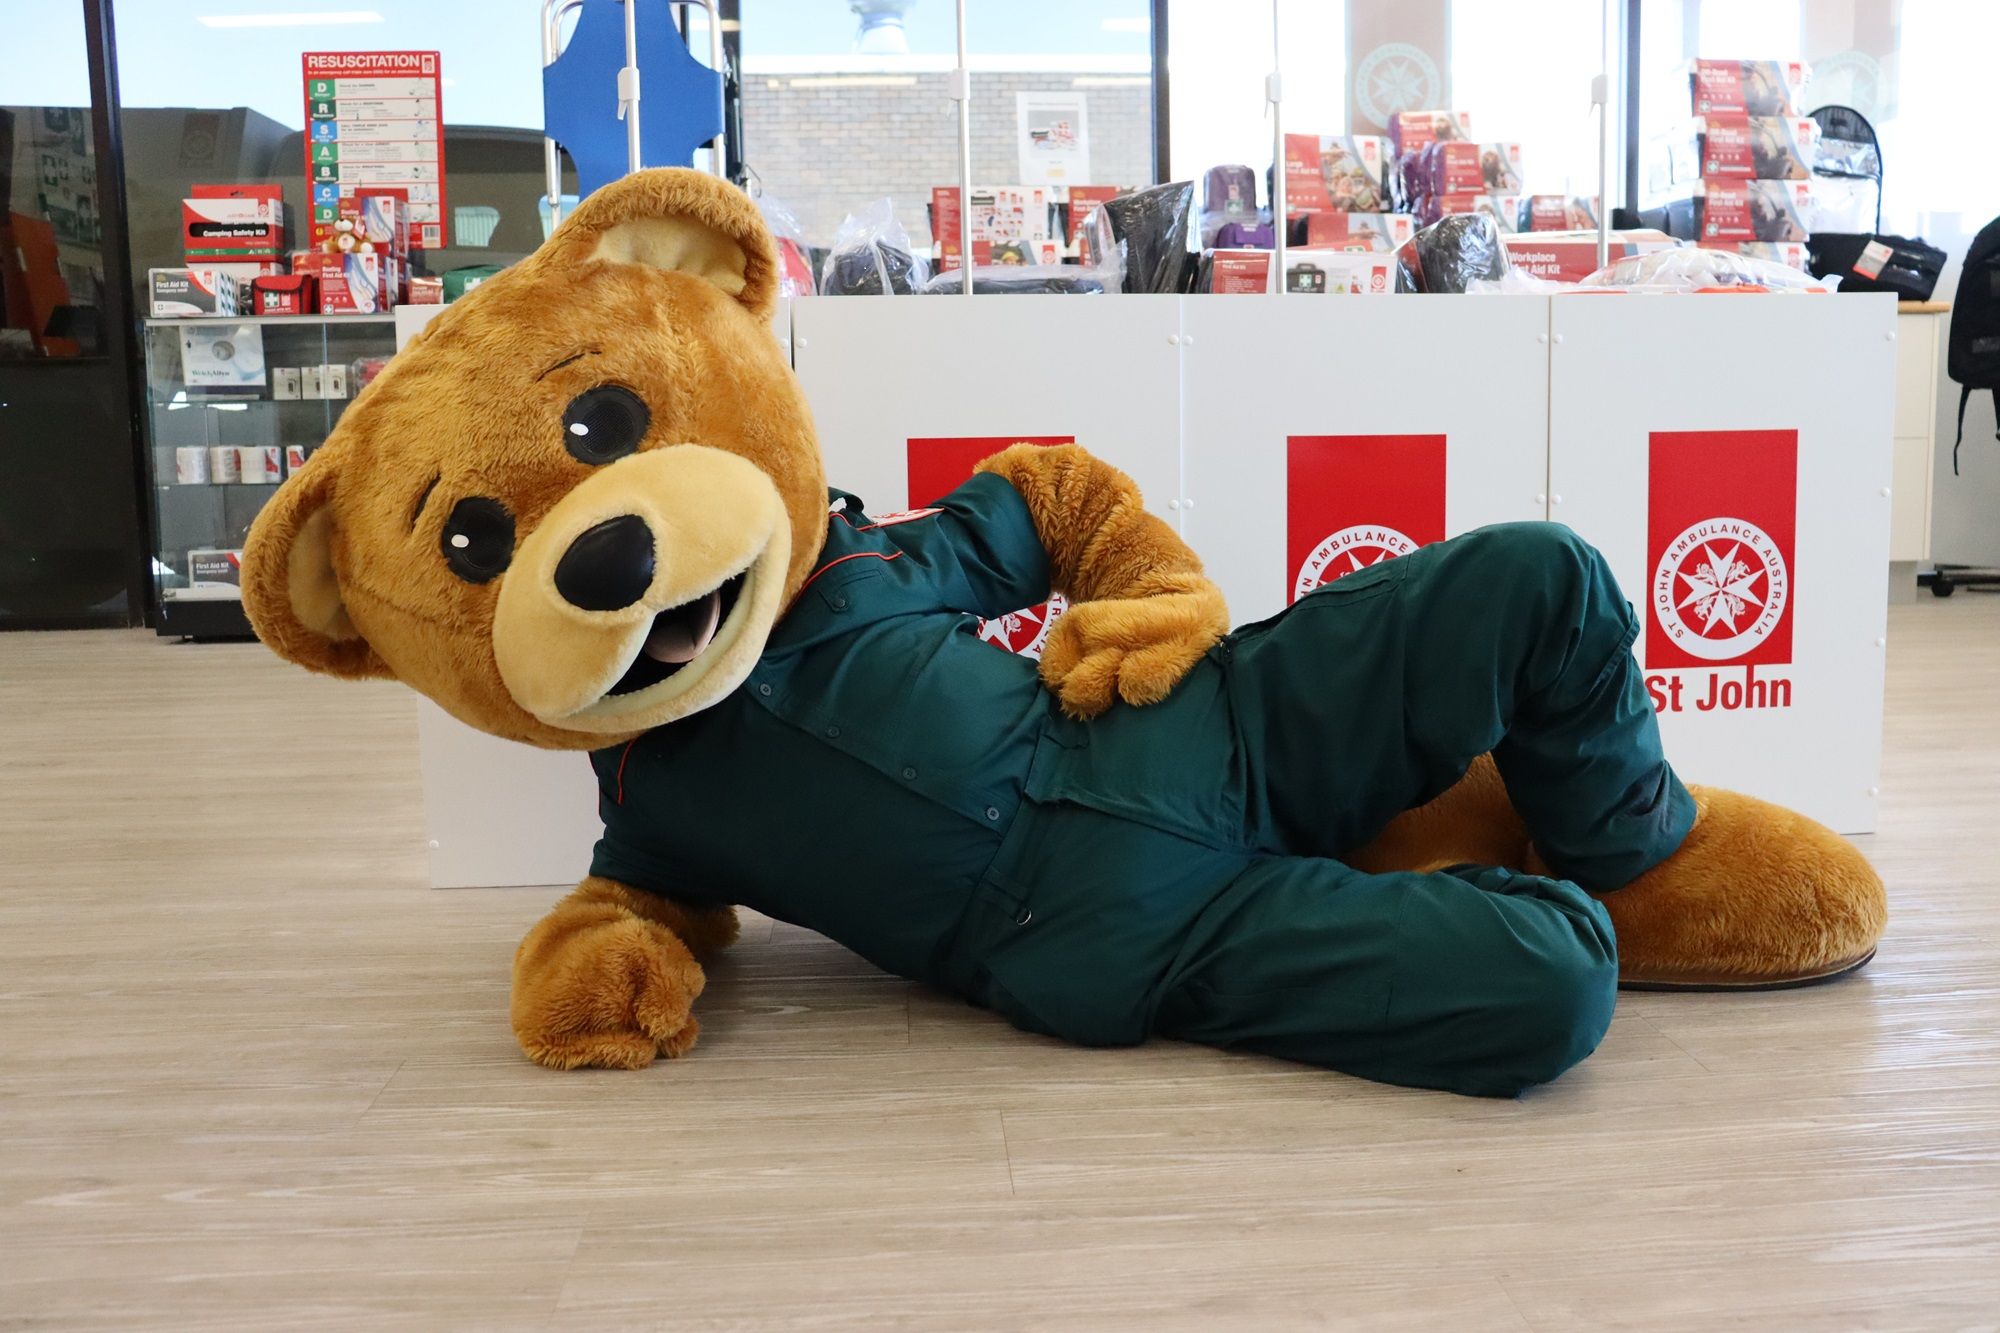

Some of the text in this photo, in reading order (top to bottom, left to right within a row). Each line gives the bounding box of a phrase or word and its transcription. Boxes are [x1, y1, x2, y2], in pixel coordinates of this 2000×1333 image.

[308, 55, 420, 68] RESUSCITATION
[317, 83, 326, 92] D
[319, 104, 328, 113] R
[320, 125, 328, 135] S
[321, 147, 330, 156] A
[321, 167, 330, 176] B
[322, 188, 332, 197] C
[323, 209, 332, 219] D
[1509, 252, 1555, 263] Workplace
[1531, 264, 1546, 274] Aid
[1548, 264, 1560, 274] Kit
[1312, 532, 1409, 569] AMBULANCE
[1660, 524, 1782, 638] ST JOHN AMBULANCE AUSTRALIA
[1645, 665, 1792, 713] St John
